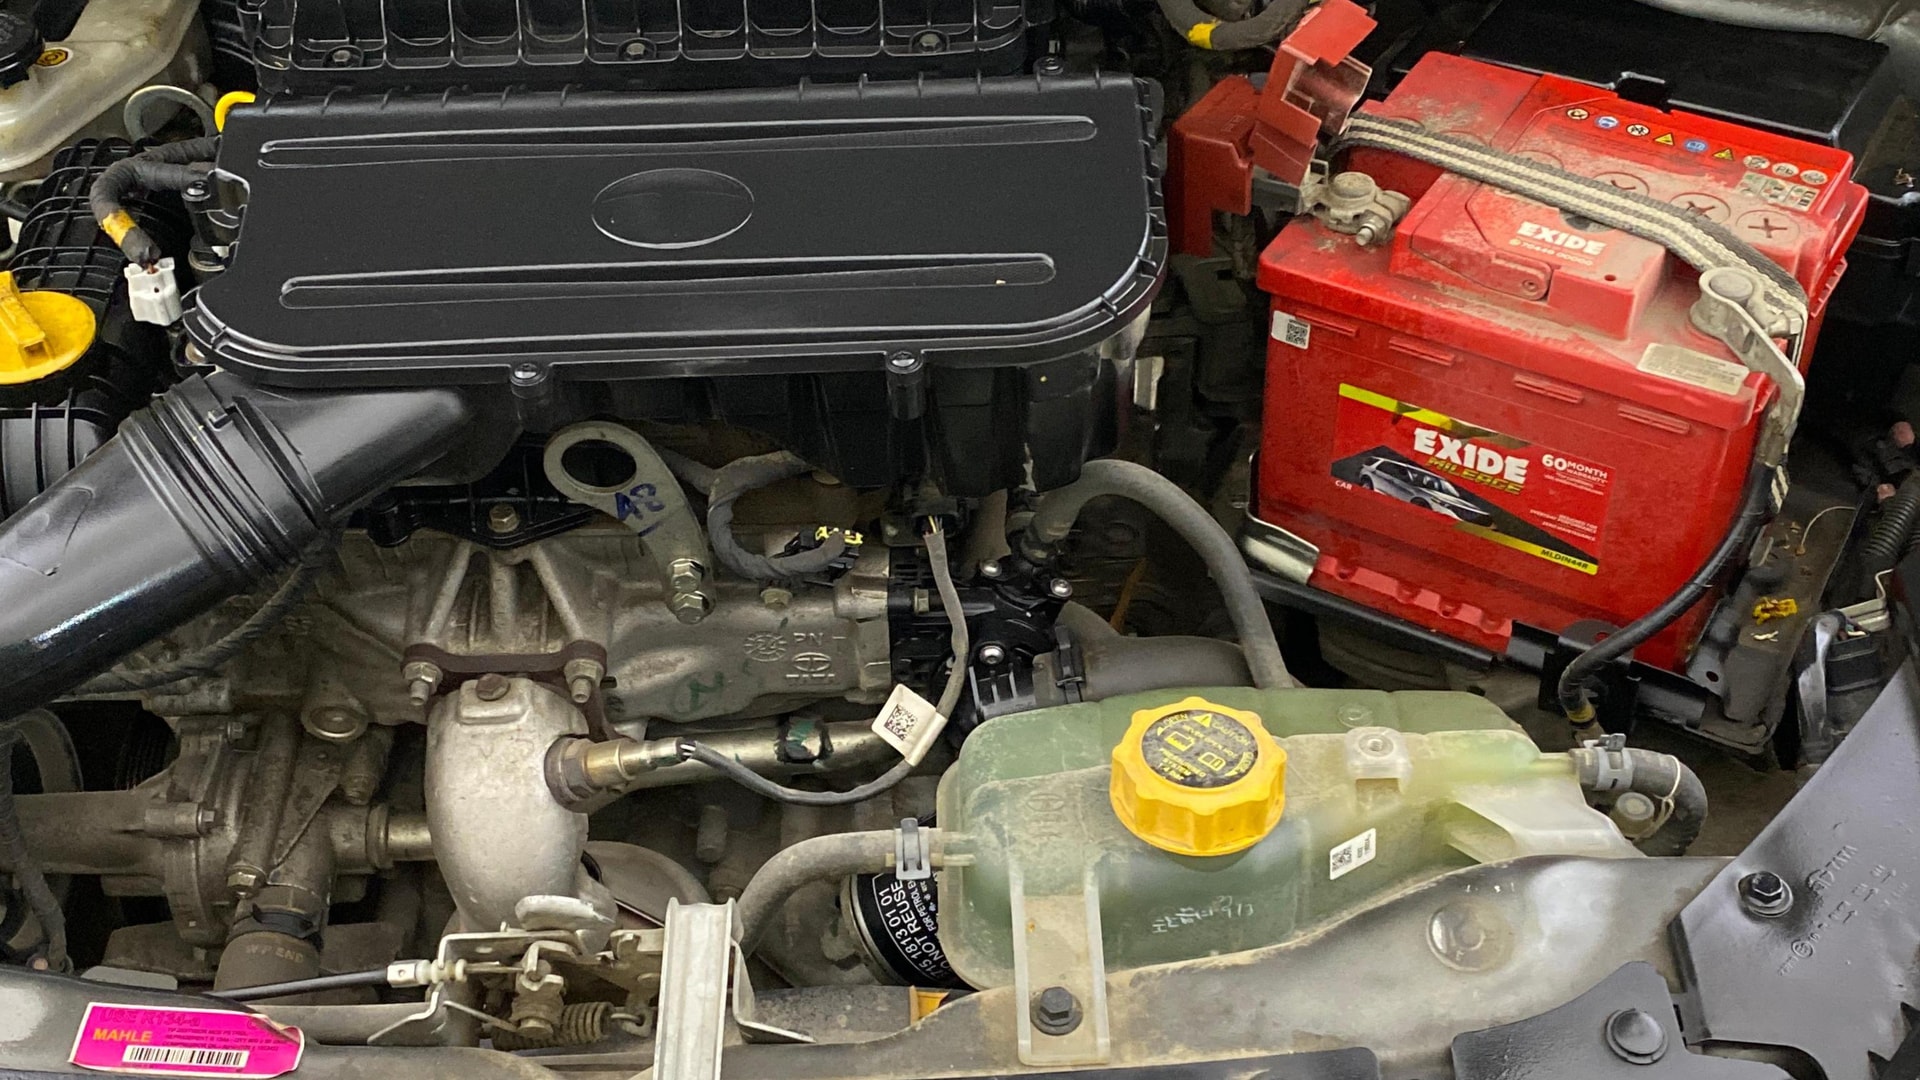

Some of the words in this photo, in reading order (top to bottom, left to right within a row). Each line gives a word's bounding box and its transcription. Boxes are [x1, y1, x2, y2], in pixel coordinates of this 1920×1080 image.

[1516, 221, 1607, 256] EXIDE
[1413, 427, 1530, 484] EXIDE
[1542, 454, 1567, 471] 60
[1567, 461, 1607, 479] MONTH
[1335, 480, 1352, 490] CAR
[1426, 456, 1525, 495] MILEAGE
[1211, 720, 1252, 746] CAUTION
[879, 887, 893, 906] 01
[890, 879, 921, 934] REUSE
[910, 888, 927, 917] PETROL
[885, 908, 901, 928] 01
[922, 915, 937, 932] FOR
[275, 947, 304, 963] END
[895, 928, 922, 959] 1813
[914, 935, 944, 961] NOT
[92, 1028, 153, 1043] MAHLE
